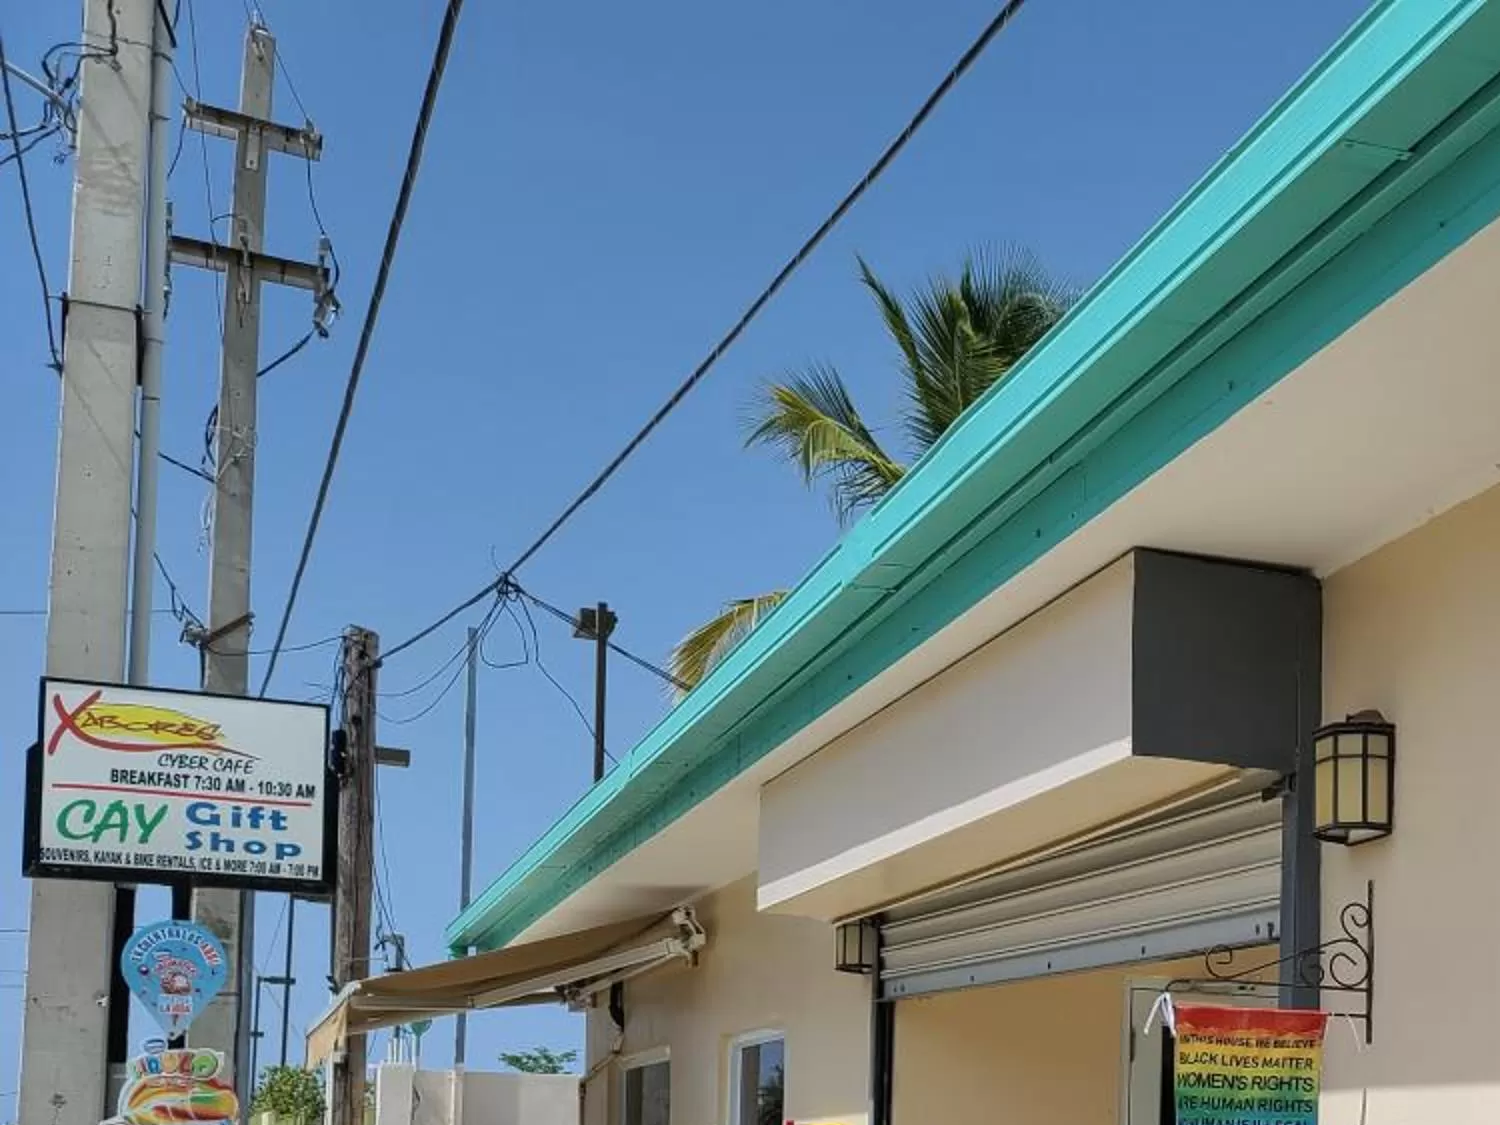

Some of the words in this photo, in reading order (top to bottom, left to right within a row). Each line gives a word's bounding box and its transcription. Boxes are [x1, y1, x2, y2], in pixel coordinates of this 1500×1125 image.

[158, 753, 209, 770] CYBER
[110, 768, 190, 789] BREAKFAST
[194, 774, 221, 792] 7:30
[226, 778, 246, 793] AM
[258, 780, 293, 798] 10:30
[296, 782, 316, 799] AM
[56, 798, 169, 845] CAY
[186, 801, 289, 832] Gift
[185, 830, 303, 860] Shop
[1178, 1051, 1219, 1065] BLACK
[1221, 1055, 1259, 1069] LIVES
[1262, 1056, 1313, 1071] MATTER
[1177, 1072, 1248, 1091] WOMEN'S
[1251, 1076, 1315, 1093] RIGHTS
[1201, 1096, 1255, 1112] HUMAN
[1257, 1099, 1314, 1114] RIGHTS
